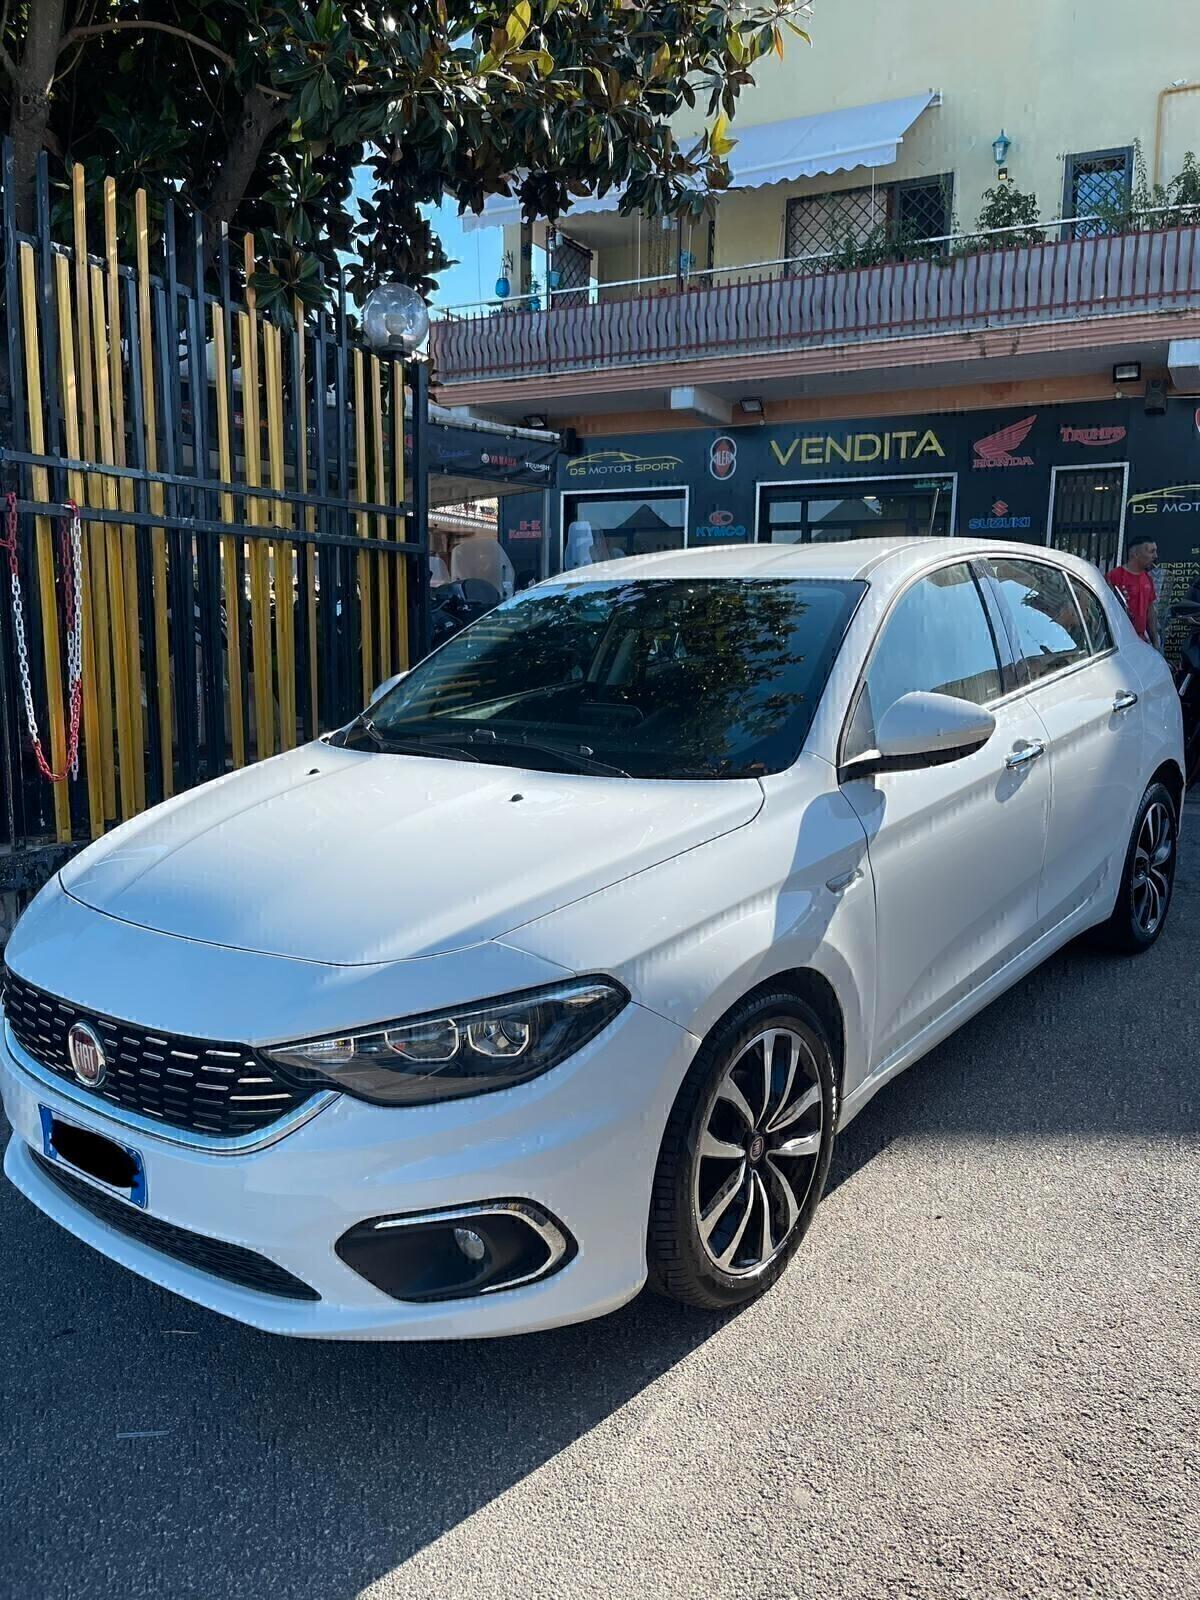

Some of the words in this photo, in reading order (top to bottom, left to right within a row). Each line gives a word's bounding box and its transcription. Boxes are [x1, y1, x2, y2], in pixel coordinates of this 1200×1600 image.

[769, 429, 945, 466] VENDITA
[490, 455, 517, 467] YAMAHA
[973, 456, 1034, 468] HONDA
[570, 467, 586, 476] DS
[588, 465, 632, 475] MOTOR
[635, 462, 677, 472] SPORT
[1132, 504, 1158, 514] DS
[969, 516, 1031, 530] SUZUKI
[696, 525, 746, 537] KYMCO
[75, 1040, 95, 1071] FIAT
